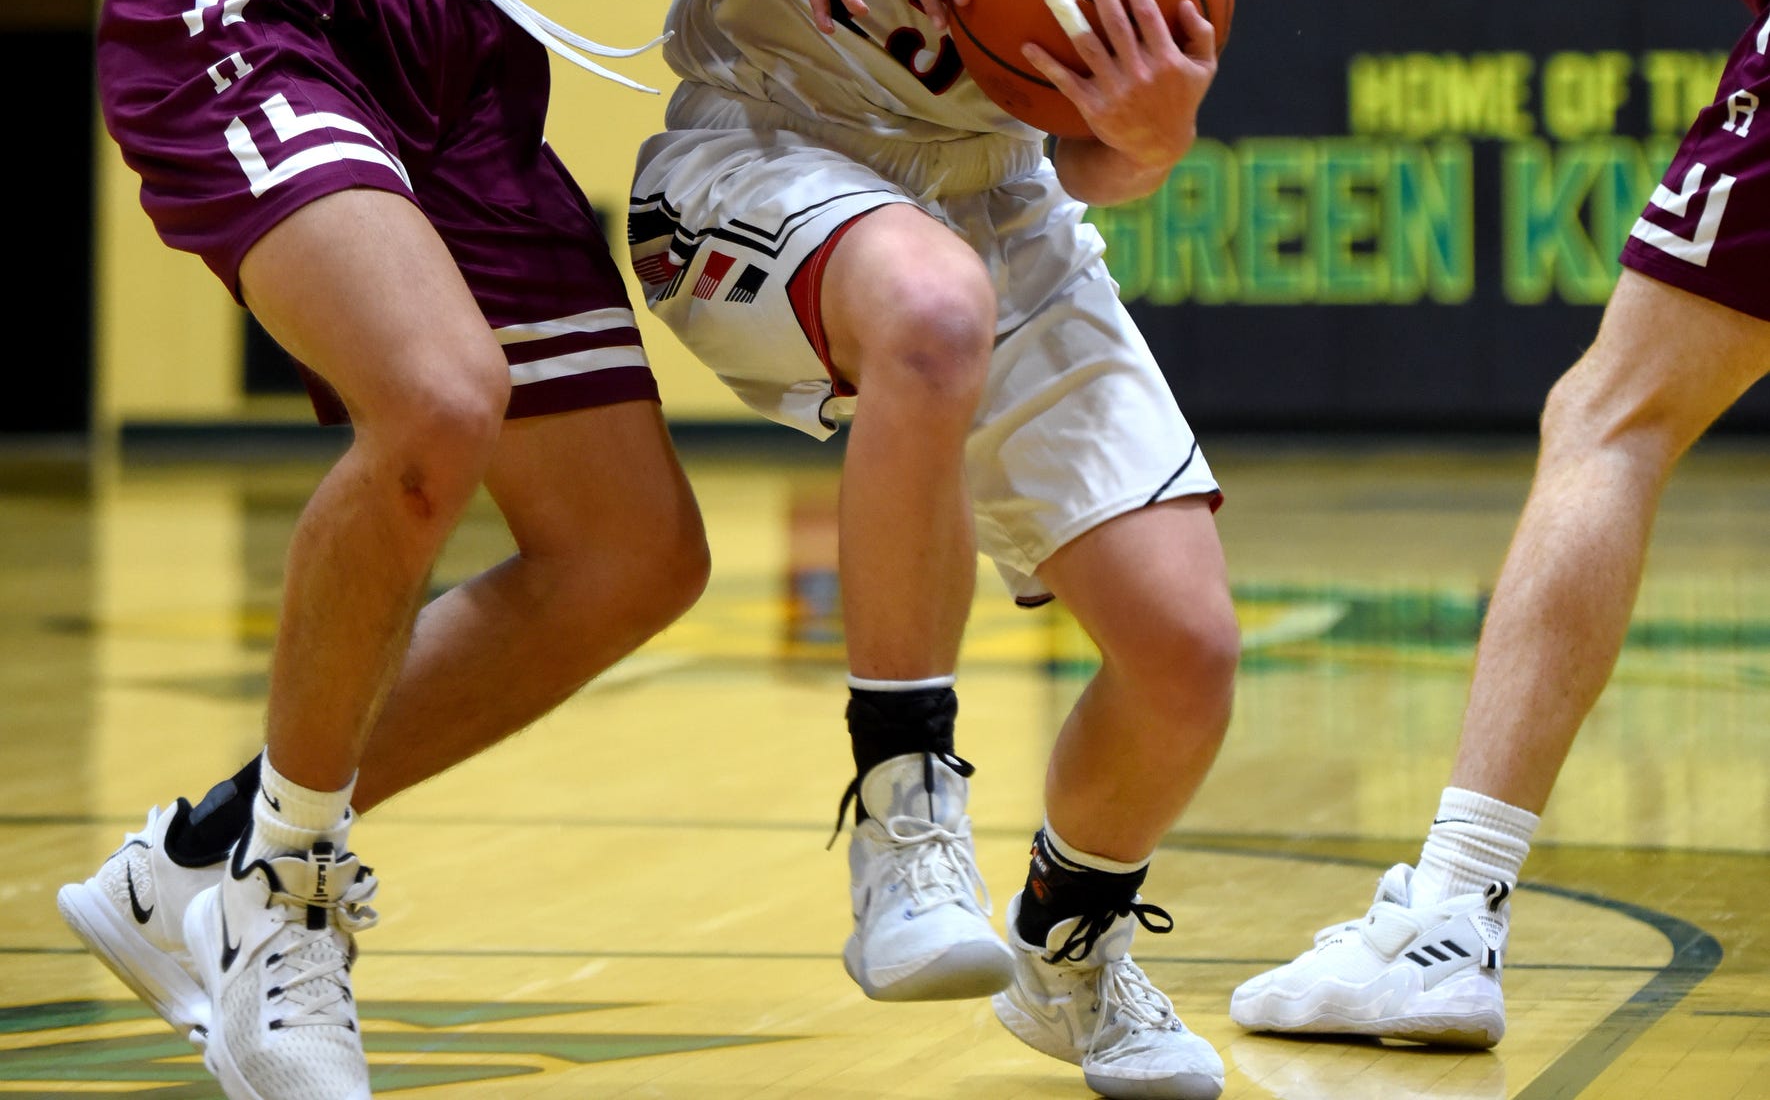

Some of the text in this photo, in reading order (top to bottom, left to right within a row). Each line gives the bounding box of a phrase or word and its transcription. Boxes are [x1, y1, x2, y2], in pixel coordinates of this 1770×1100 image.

[1347, 50, 1536, 140] HOME
[1544, 50, 1630, 139] OF
[1722, 88, 1760, 139] R
